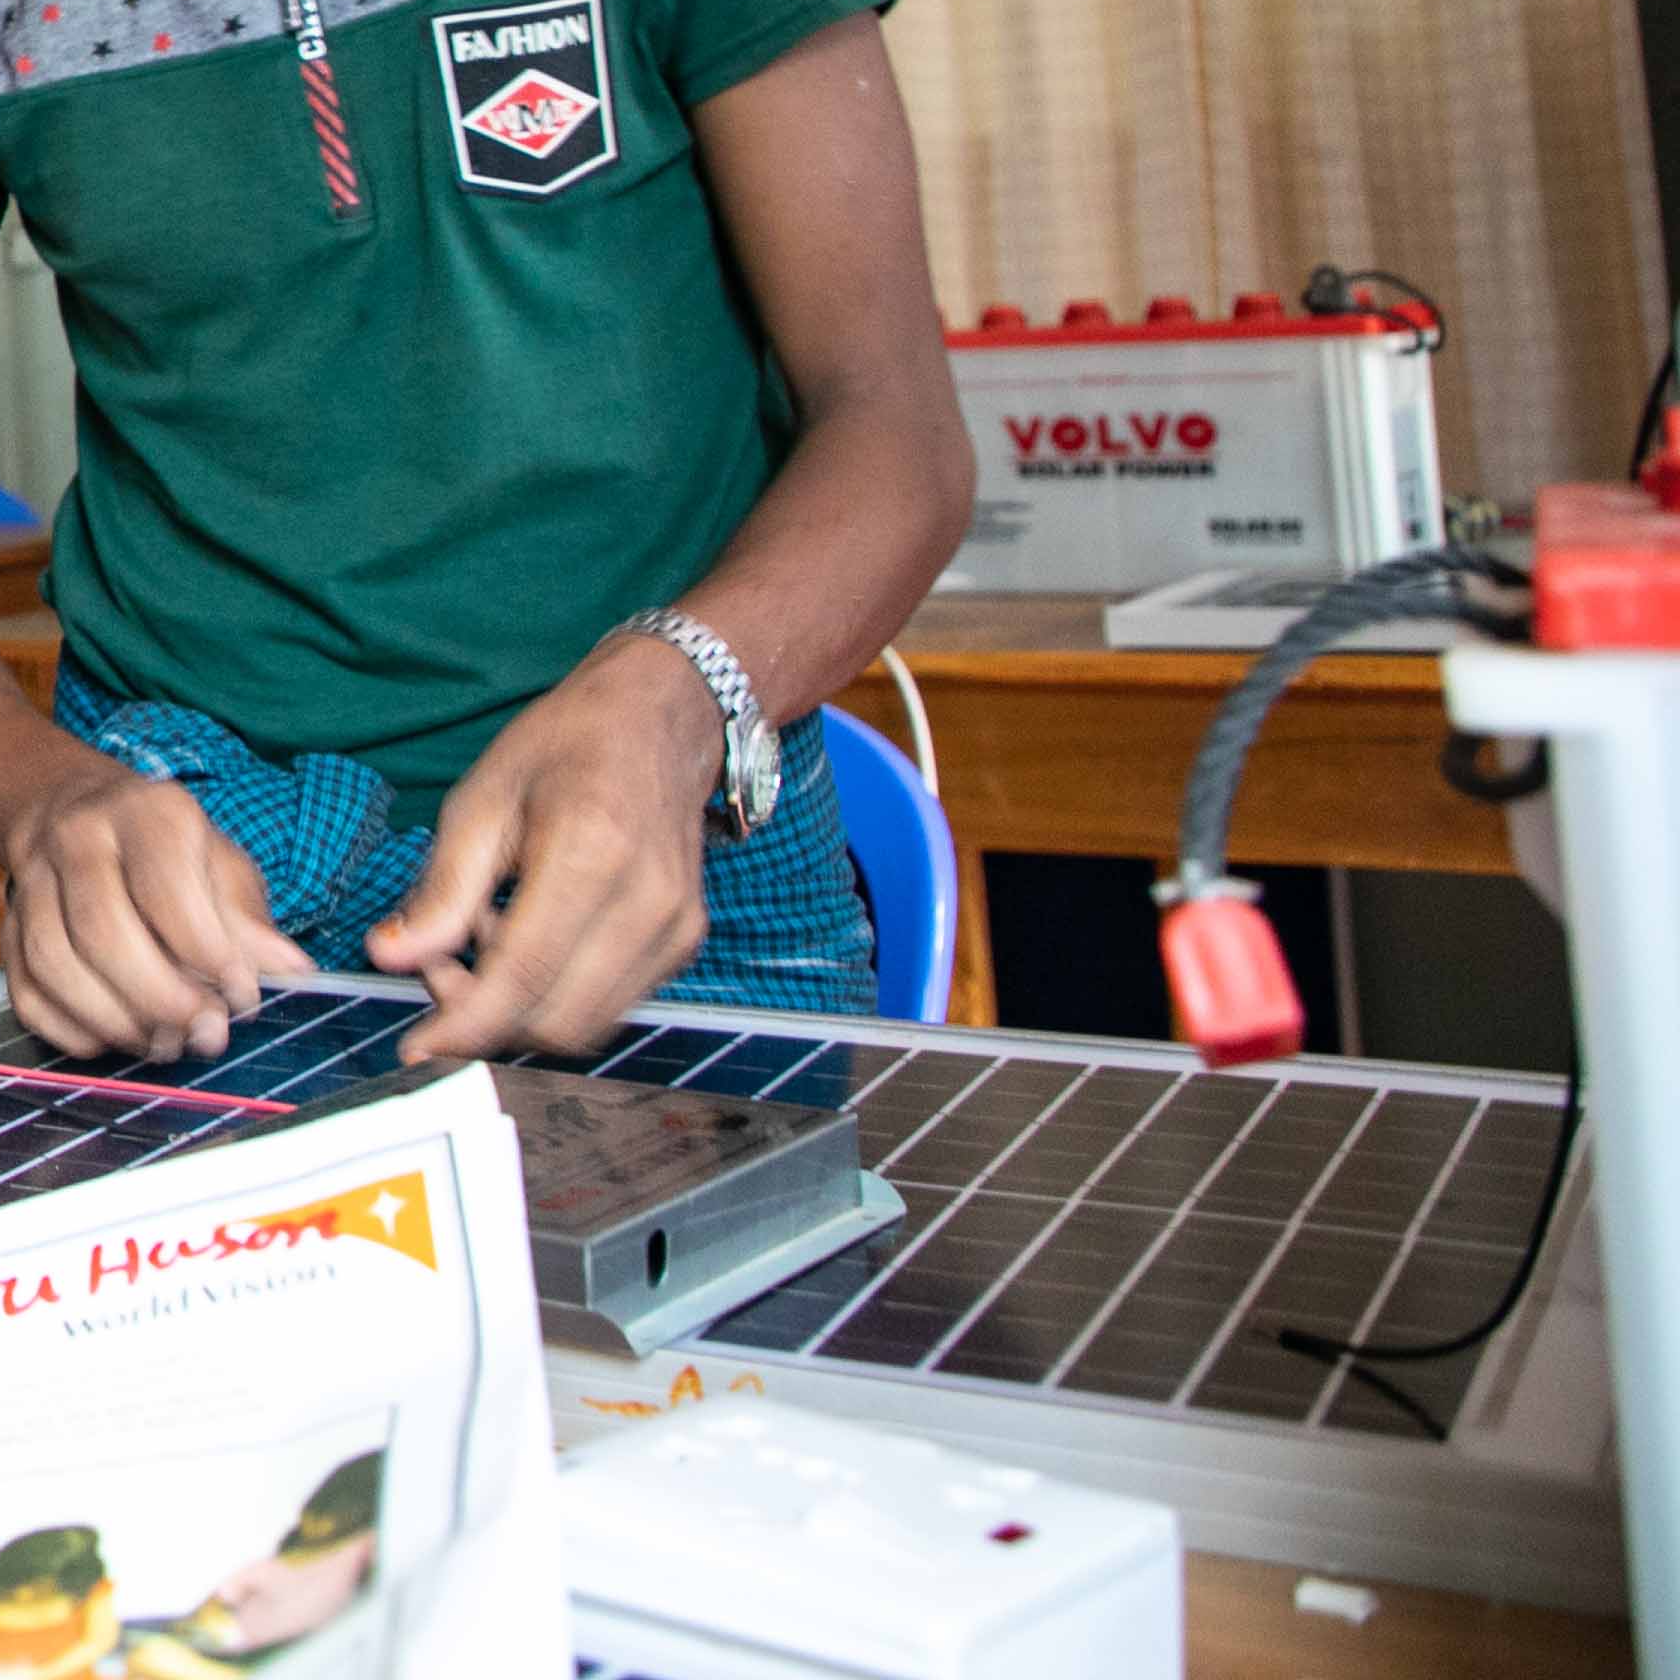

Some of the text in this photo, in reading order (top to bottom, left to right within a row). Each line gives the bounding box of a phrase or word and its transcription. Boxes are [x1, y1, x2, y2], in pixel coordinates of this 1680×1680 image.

[451, 14, 591, 63] FASHION
[1003, 410, 1218, 457] VOLVO
[1115, 458, 1217, 477] POWER
